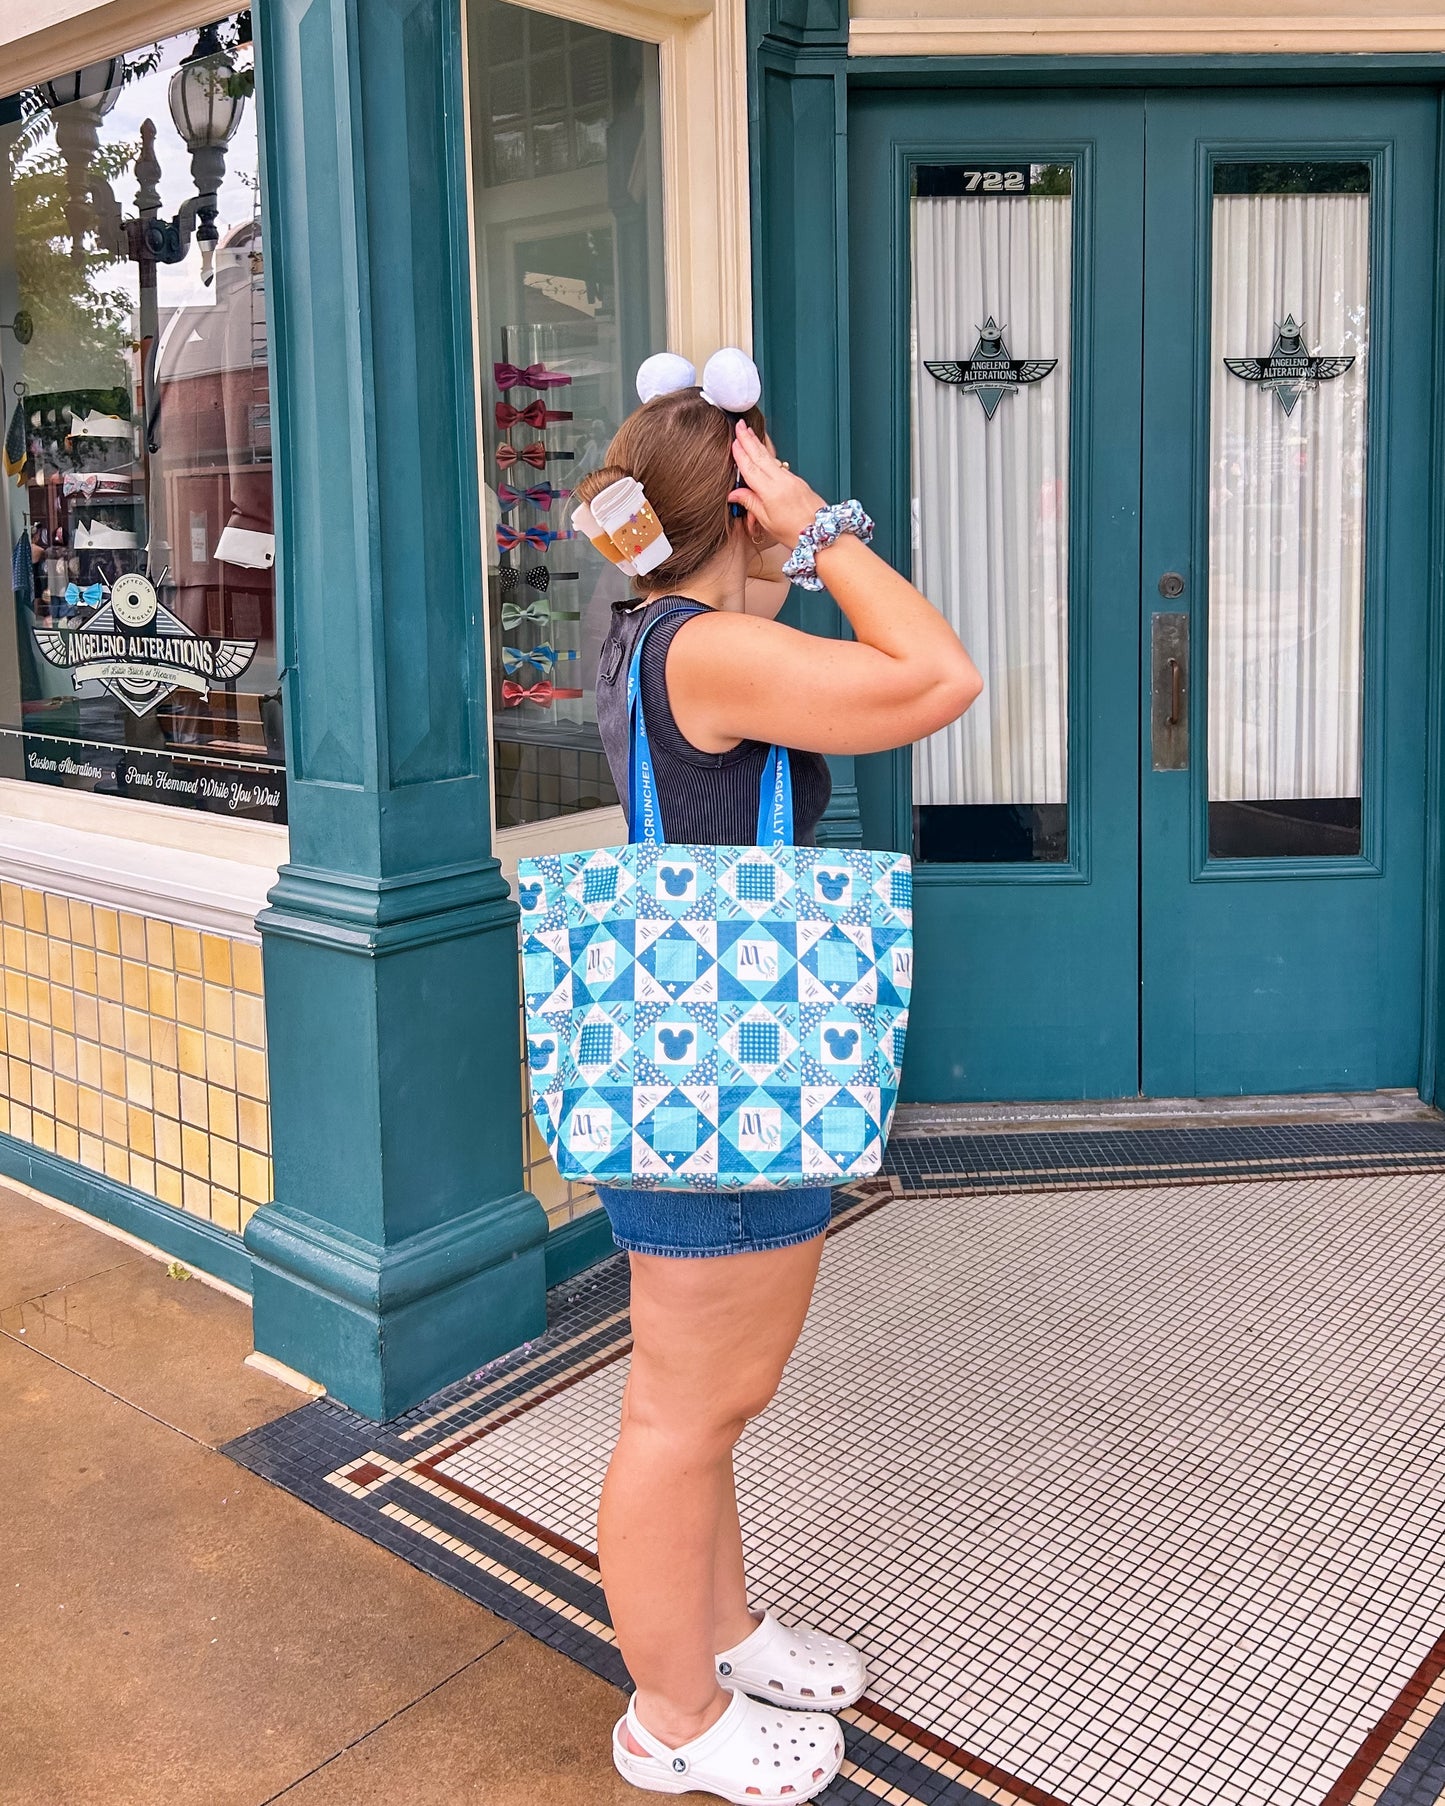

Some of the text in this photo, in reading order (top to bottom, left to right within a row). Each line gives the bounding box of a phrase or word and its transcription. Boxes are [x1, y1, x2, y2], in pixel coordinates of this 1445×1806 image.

[963, 171, 1025, 191] 722
[971, 361, 1010, 370] ANGELENO
[1270, 358, 1309, 367] ANGELENO
[963, 370, 1017, 381] ALTERATIONS
[1263, 367, 1316, 378] ALTERATIONS
[116, 579, 143, 592] CRAFTED
[127, 605, 153, 620] ANGELES
[68, 633, 213, 675] ANGELENO ALTERATIONS
[28, 752, 102, 779] Custom Alterations
[125, 766, 281, 809] Pants Hemmed While You Wait
[773, 760, 784, 836] MAGICALLY
